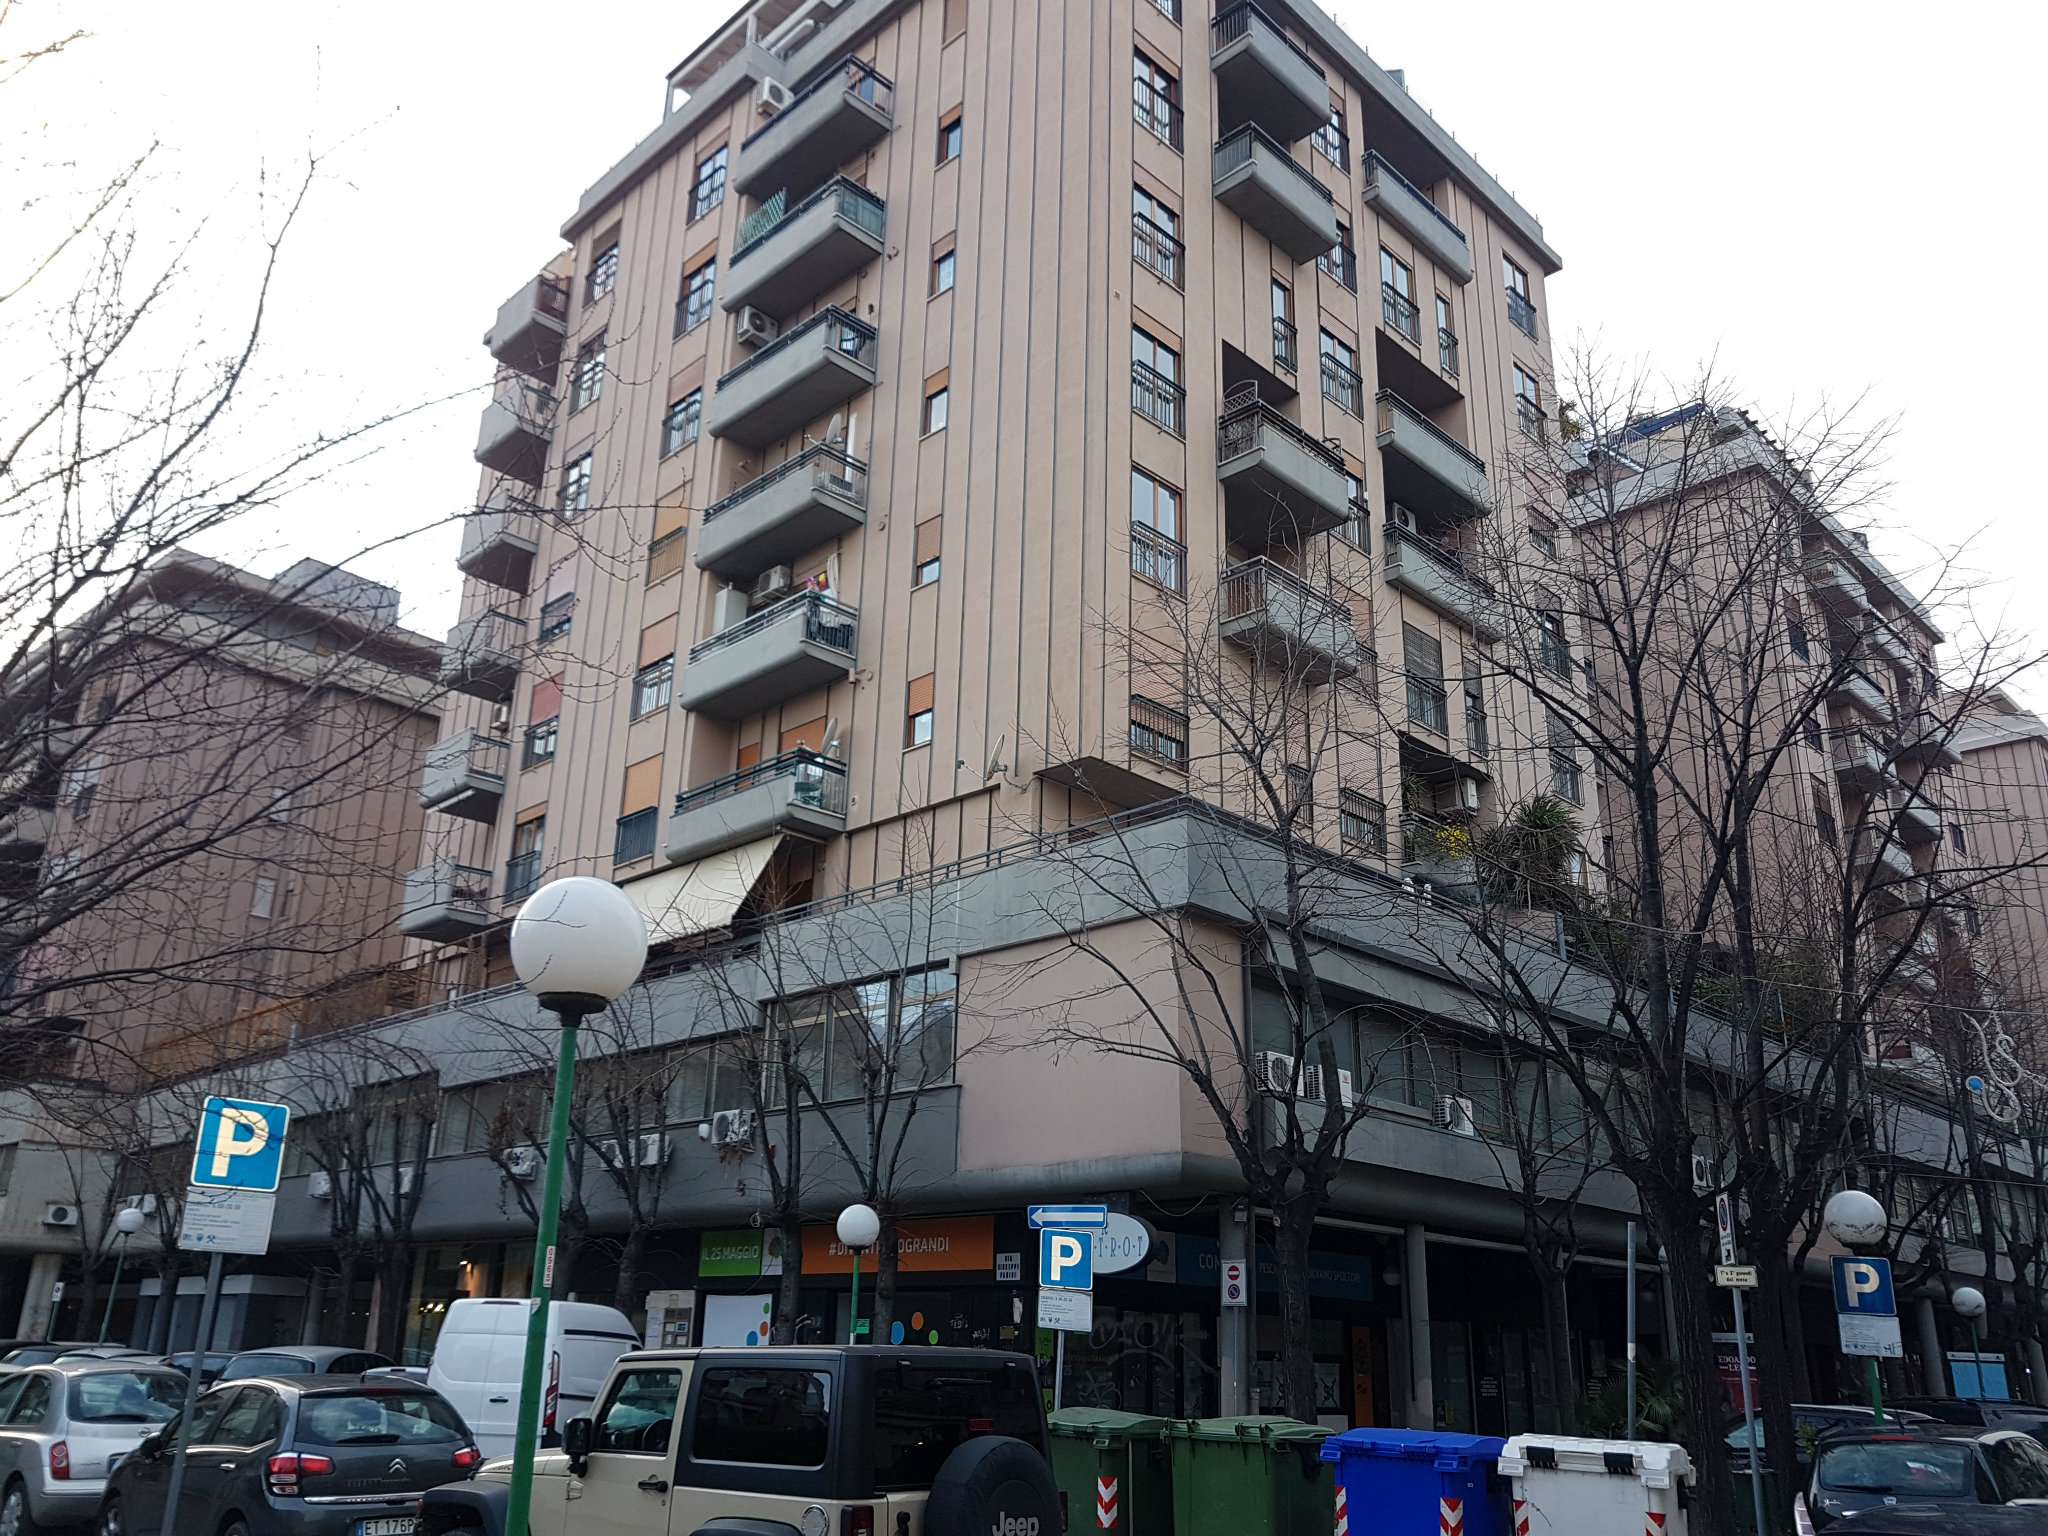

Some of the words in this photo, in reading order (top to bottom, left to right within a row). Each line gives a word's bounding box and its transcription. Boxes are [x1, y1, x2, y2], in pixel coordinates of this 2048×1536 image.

[211, 1107, 269, 1177] P
[711, 1247, 721, 1260] 25
[722, 1245, 759, 1260] MAGGIO
[1050, 1235, 1083, 1281] P
[1843, 1263, 1880, 1307] P
[1718, 1355, 1757, 1364] EDOAO
[365, 1520, 380, 1536] ET
[991, 1511, 1040, 1536] Jeep
